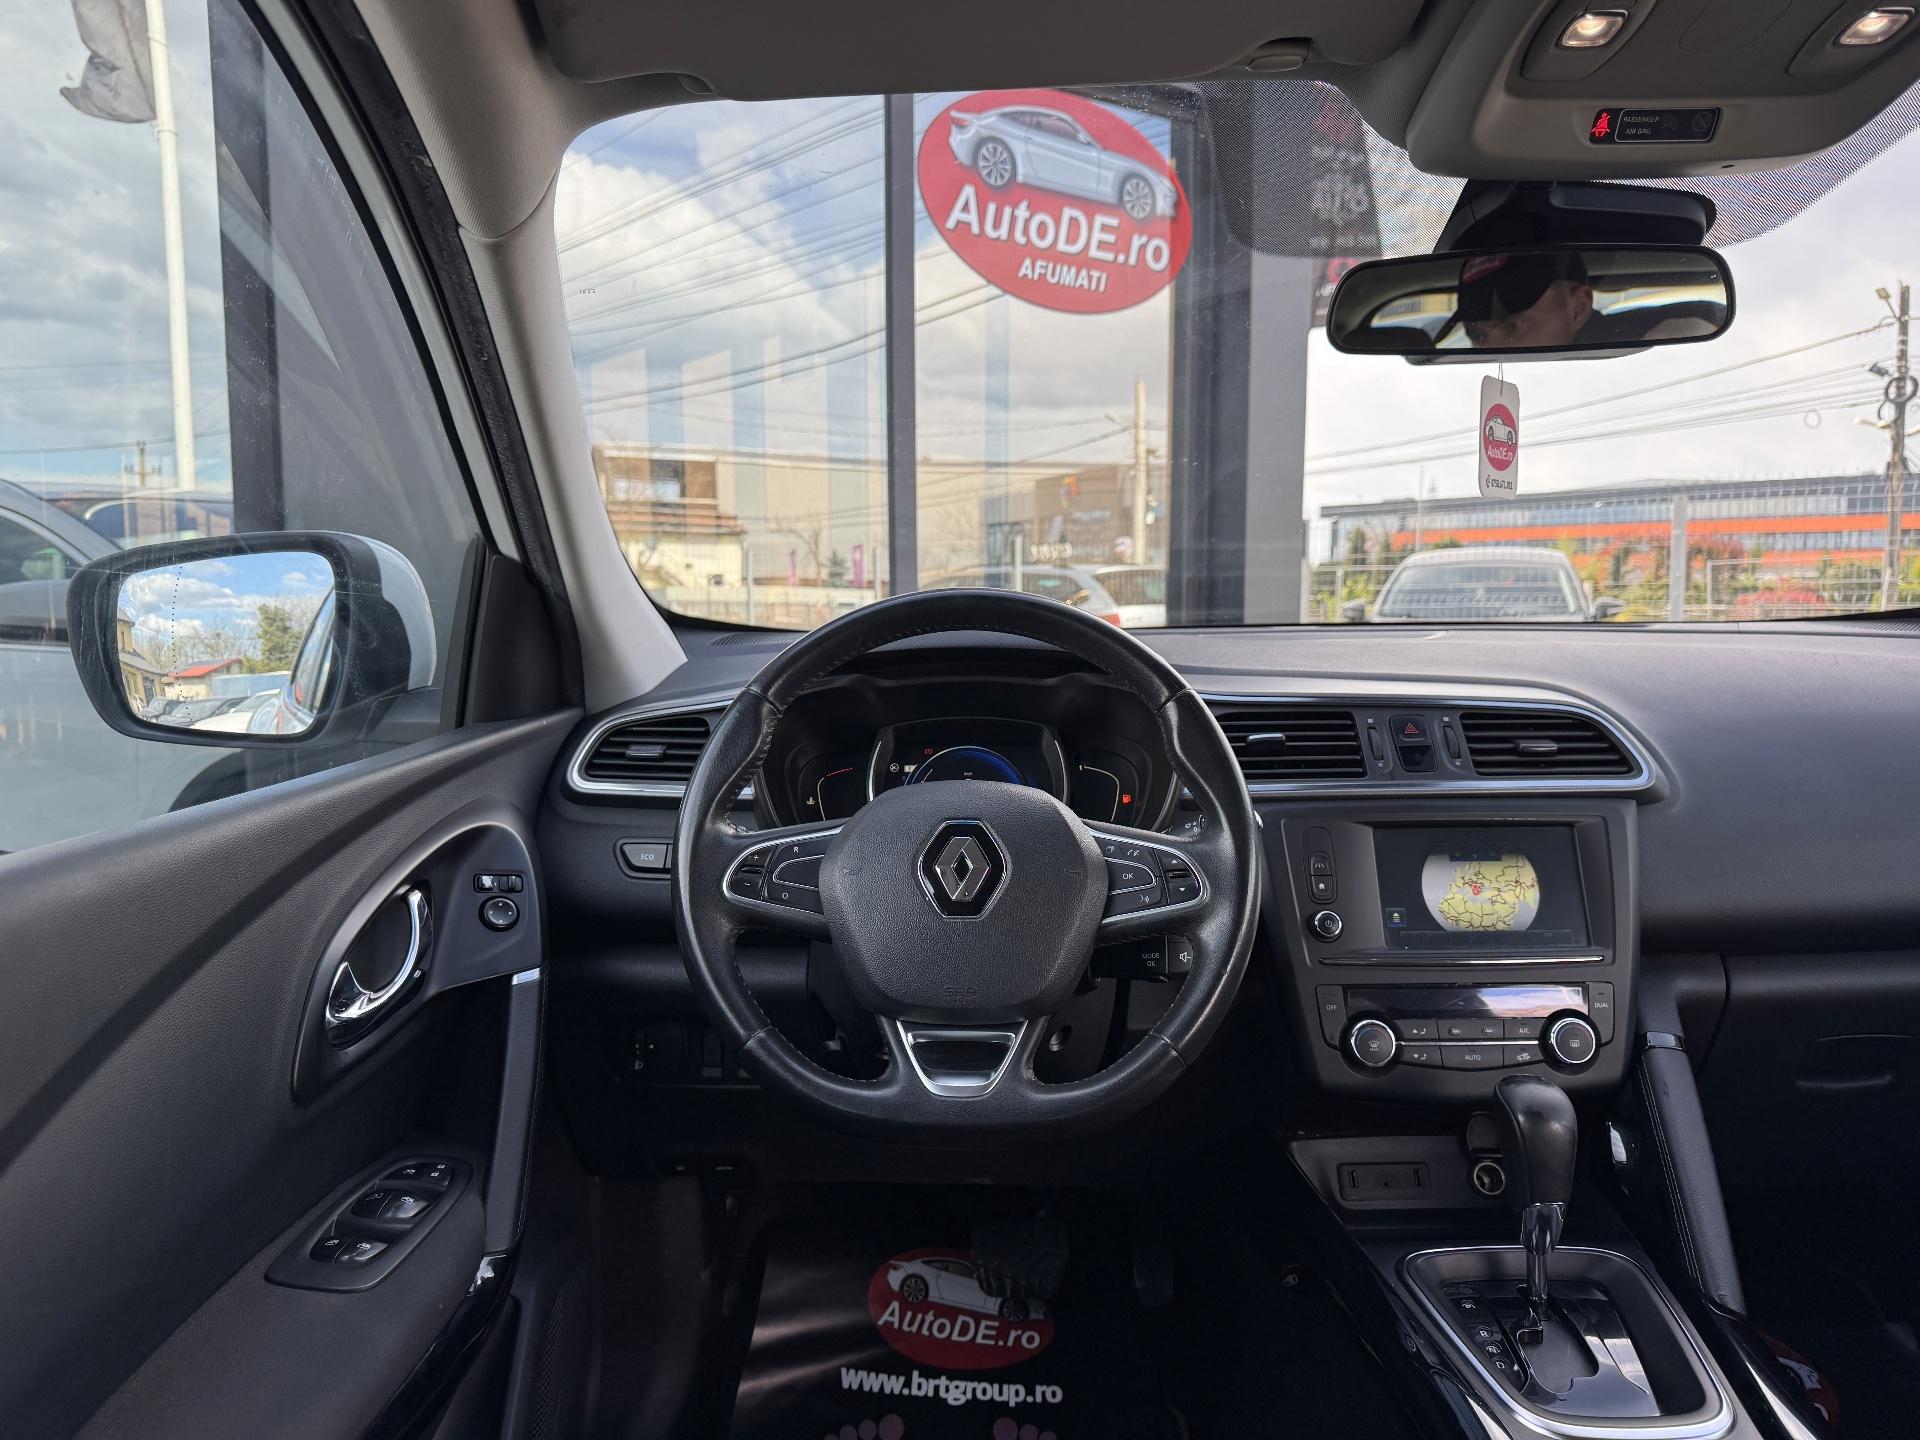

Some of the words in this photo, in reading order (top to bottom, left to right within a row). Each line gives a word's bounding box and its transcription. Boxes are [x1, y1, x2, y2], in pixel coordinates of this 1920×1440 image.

[1623, 115, 1660, 123] PASSENGER
[945, 184, 1170, 271] AutoDE.ro
[1017, 257, 1107, 292] AFUMATI
[640, 853, 655, 861] ECO
[1122, 872, 1134, 880] OK
[1141, 952, 1160, 960] MODE
[1518, 1026, 1530, 1034] A/C
[1464, 1053, 1481, 1061] AUTO
[877, 1301, 1041, 1350] AutoDE.ro
[840, 1367, 1063, 1407] www.brtgroup.ro
